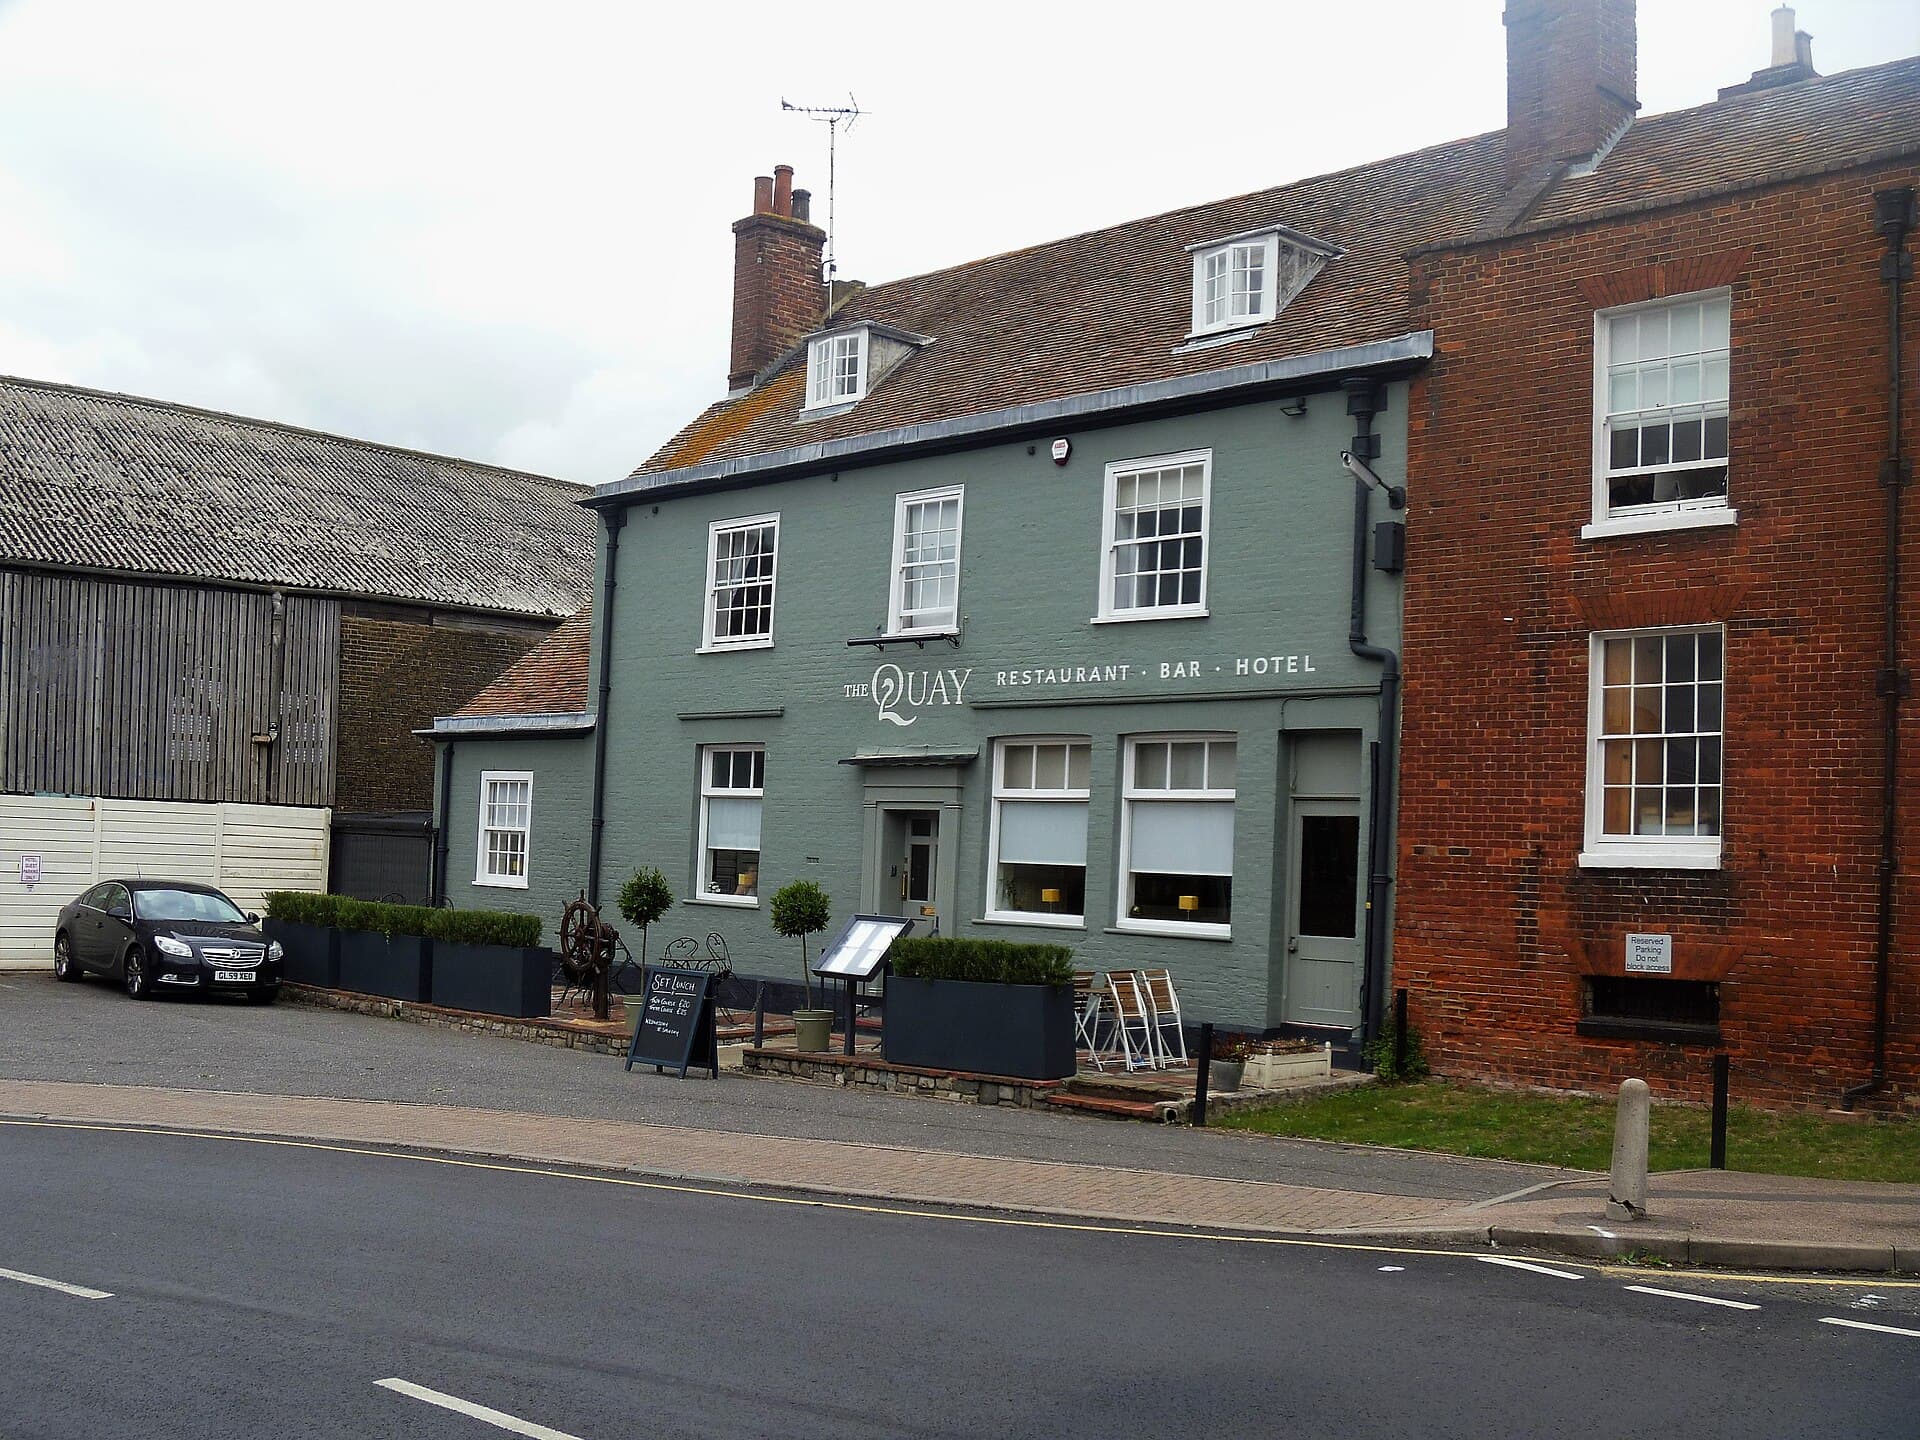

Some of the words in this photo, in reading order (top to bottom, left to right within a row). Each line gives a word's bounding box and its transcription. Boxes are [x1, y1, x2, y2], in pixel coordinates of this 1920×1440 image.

[997, 664, 1130, 687] RESTAURANT
[1160, 660, 1201, 679] BAR
[1236, 655, 1316, 676] HOTEL
[844, 683, 869, 698] THE
[872, 663, 972, 726] QUAY
[1631, 936, 1664, 945] Reserved
[1635, 945, 1662, 955] Parking
[1636, 954, 1646, 962] Do
[1627, 962, 1645, 970] block
[1646, 964, 1670, 972] access
